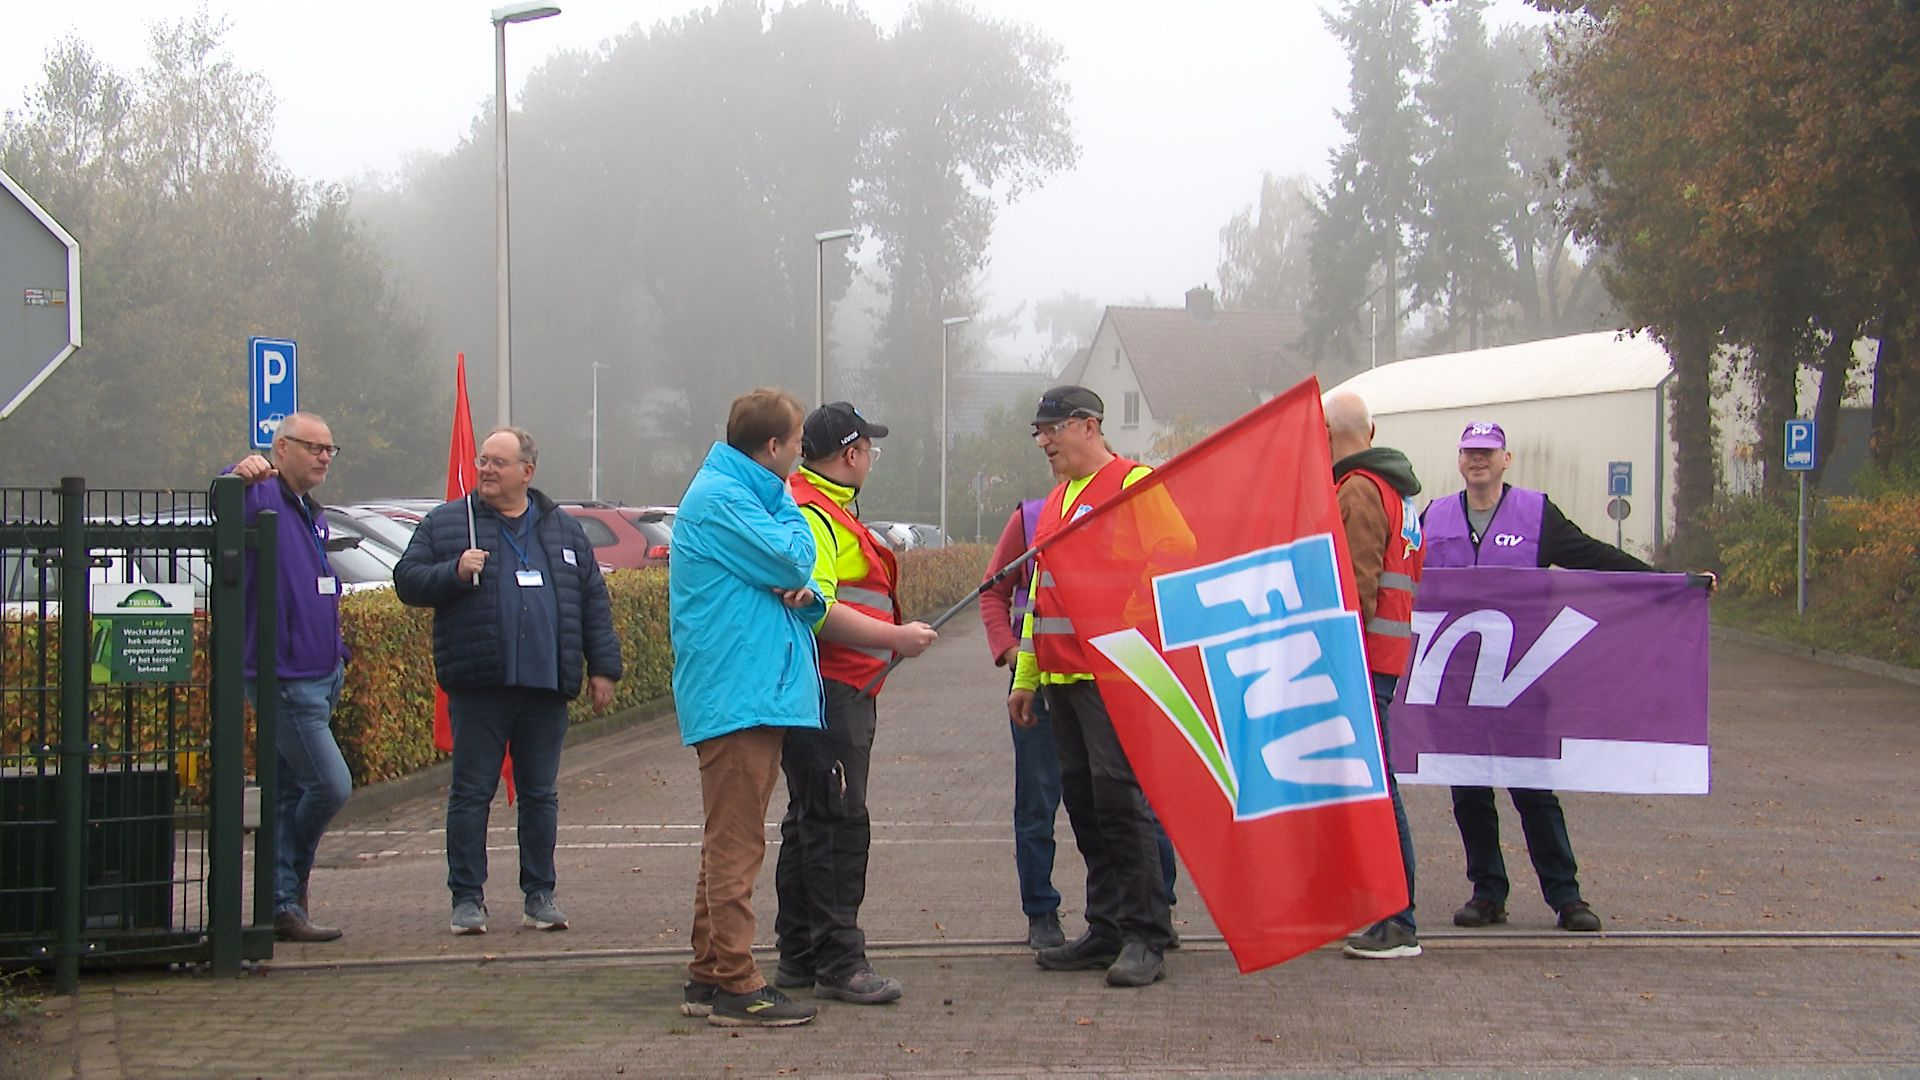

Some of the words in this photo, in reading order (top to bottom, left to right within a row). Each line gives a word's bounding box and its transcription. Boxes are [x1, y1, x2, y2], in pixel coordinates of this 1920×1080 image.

[263, 350, 287, 404] P
[1791, 425, 1808, 450] P
[154, 619, 167, 628] op!
[123, 628, 147, 636] Wacht
[148, 628, 171, 636] totdat
[172, 628, 185, 636] het
[142, 637, 172, 646] volledig
[122, 647, 155, 656] geopend
[129, 656, 137, 665] je
[1195, 559, 1374, 788] FNV
